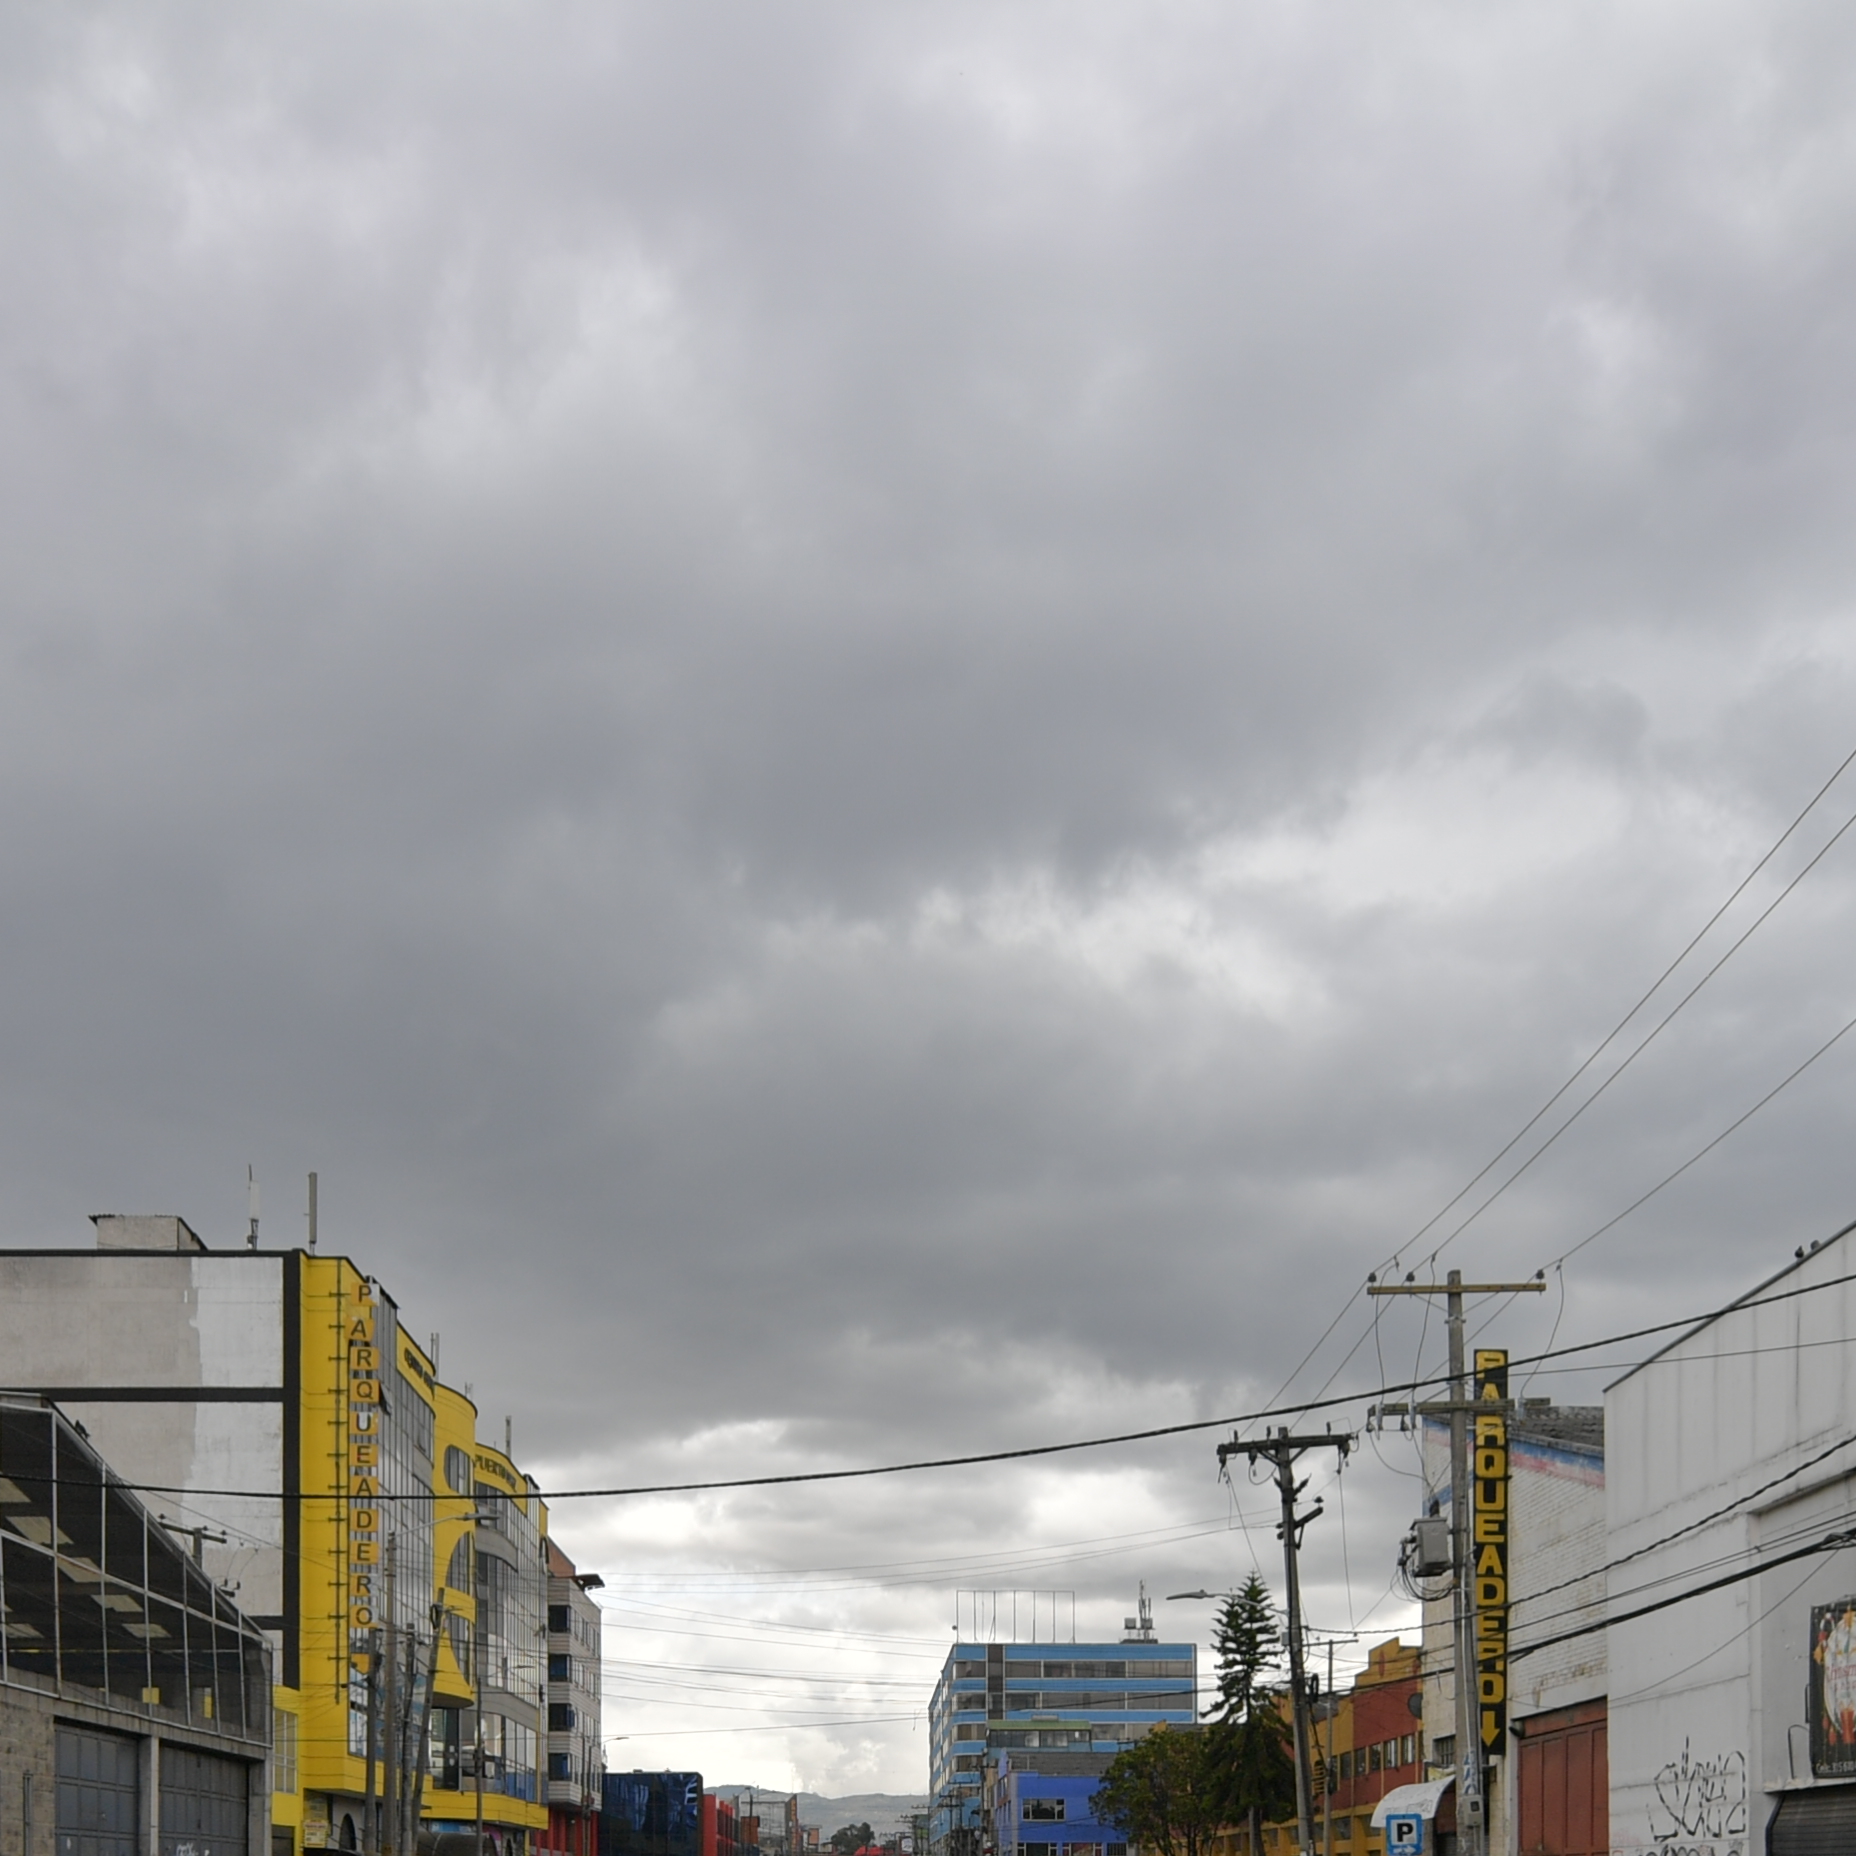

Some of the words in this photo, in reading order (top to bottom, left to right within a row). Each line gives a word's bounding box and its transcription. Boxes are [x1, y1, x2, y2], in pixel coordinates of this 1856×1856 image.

[350, 1284, 374, 1627] PARQUEADERO
[1475, 1351, 1505, 1704] PARQUEADERO
[1397, 1823, 1413, 1842] P
